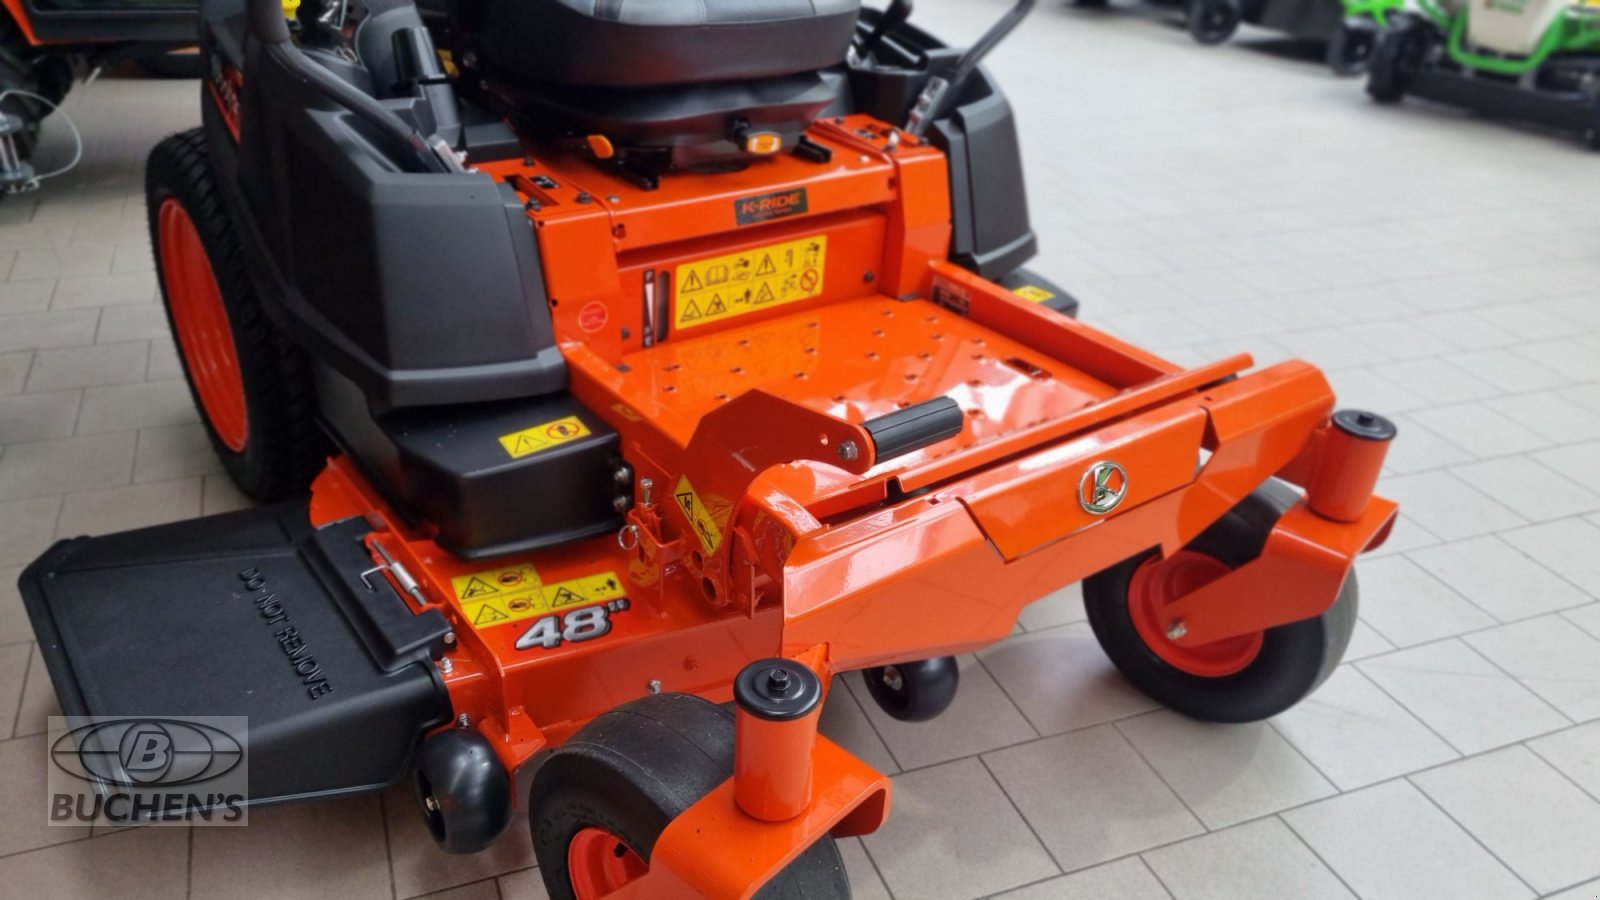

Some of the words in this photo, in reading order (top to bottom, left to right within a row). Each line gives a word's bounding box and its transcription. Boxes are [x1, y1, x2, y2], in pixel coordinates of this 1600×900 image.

[741, 193, 802, 214] K-RIDE
[239, 567, 266, 592] DO
[254, 593, 289, 625] NOT
[273, 626, 333, 700] REMOVE
